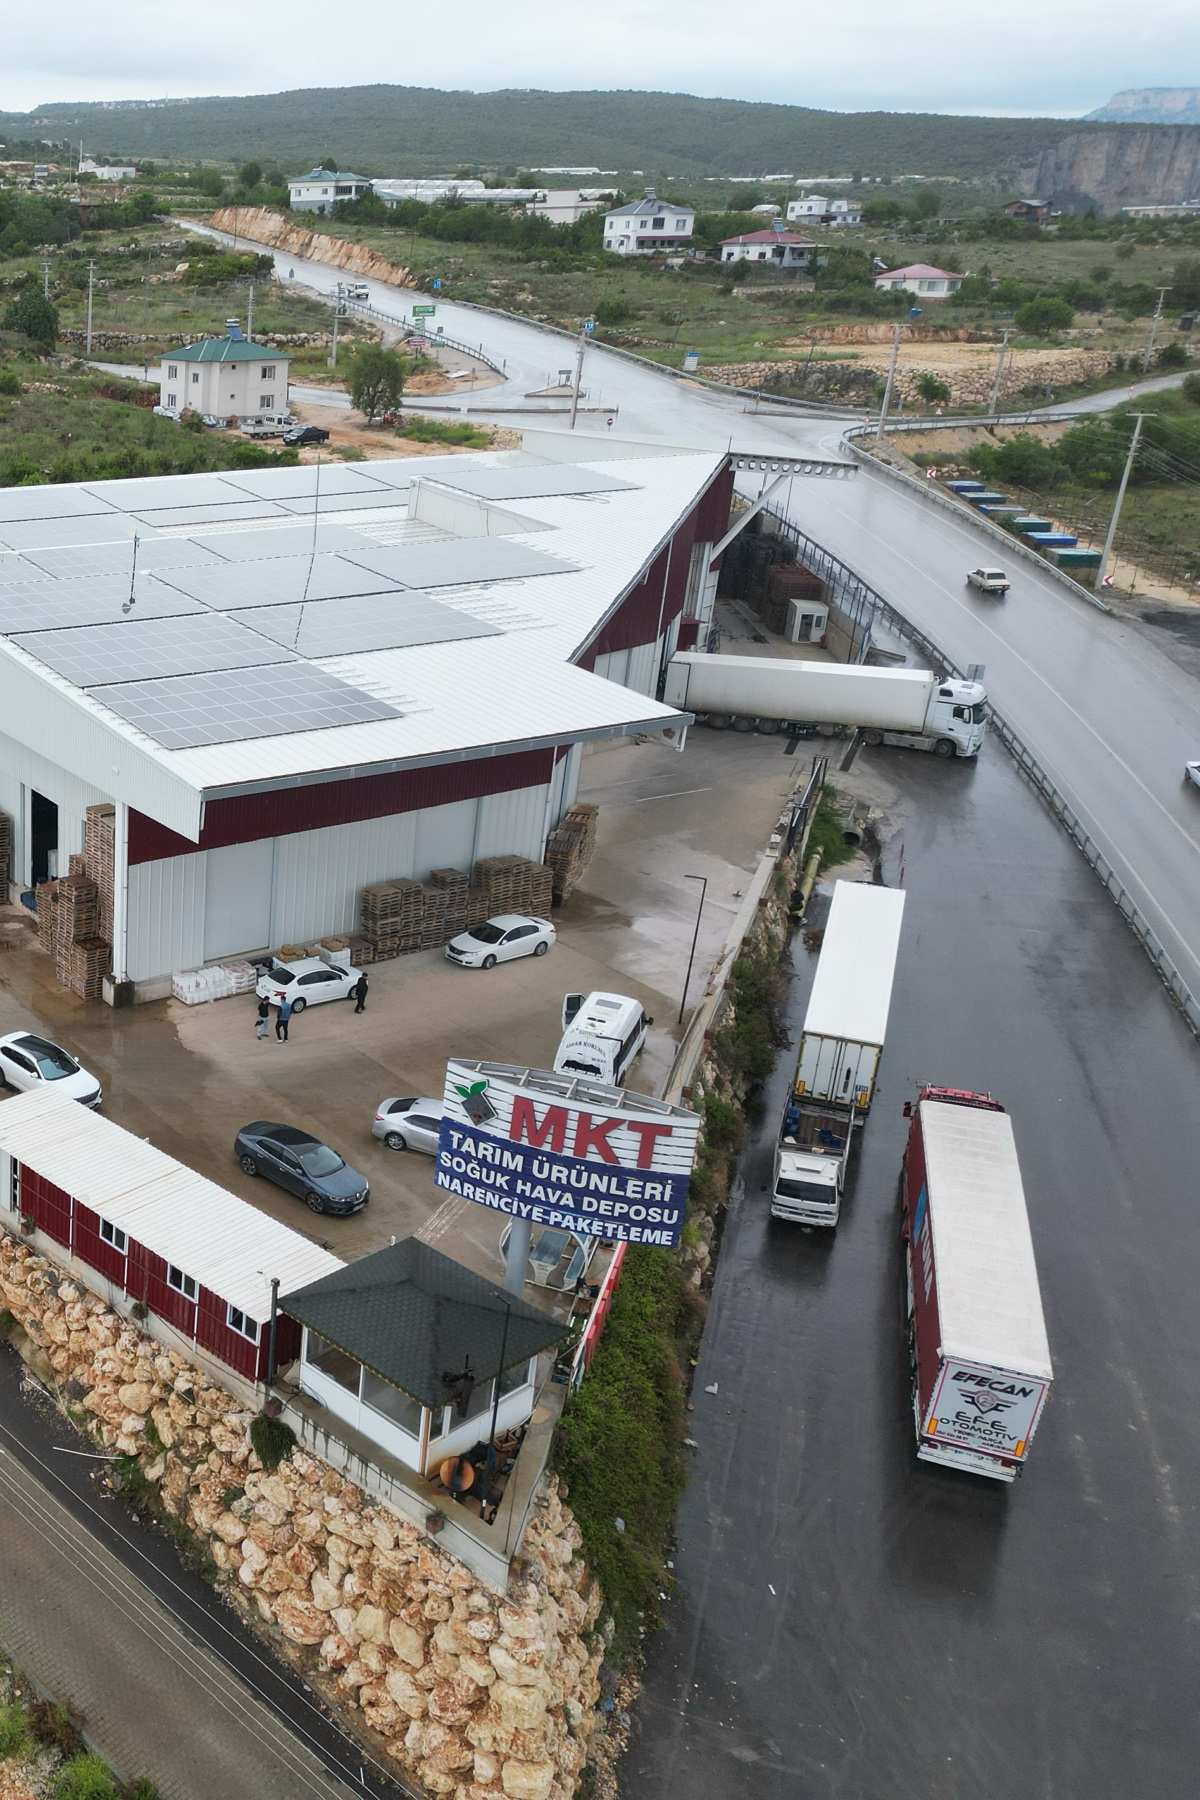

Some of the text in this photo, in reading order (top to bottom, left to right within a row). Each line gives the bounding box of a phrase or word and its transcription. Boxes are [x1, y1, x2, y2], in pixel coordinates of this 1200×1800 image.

[449, 1130, 673, 1202] TARIM ÜRÜNLERİ
[509, 1095, 673, 1169] MKT
[437, 1171, 674, 1246] NARENCİYE PAKETLEME
[440, 1151, 679, 1225] SOĞUK HAVA DEPOSU
[952, 1371, 1034, 1398] EFECAN
[955, 1411, 1007, 1432] EFE
